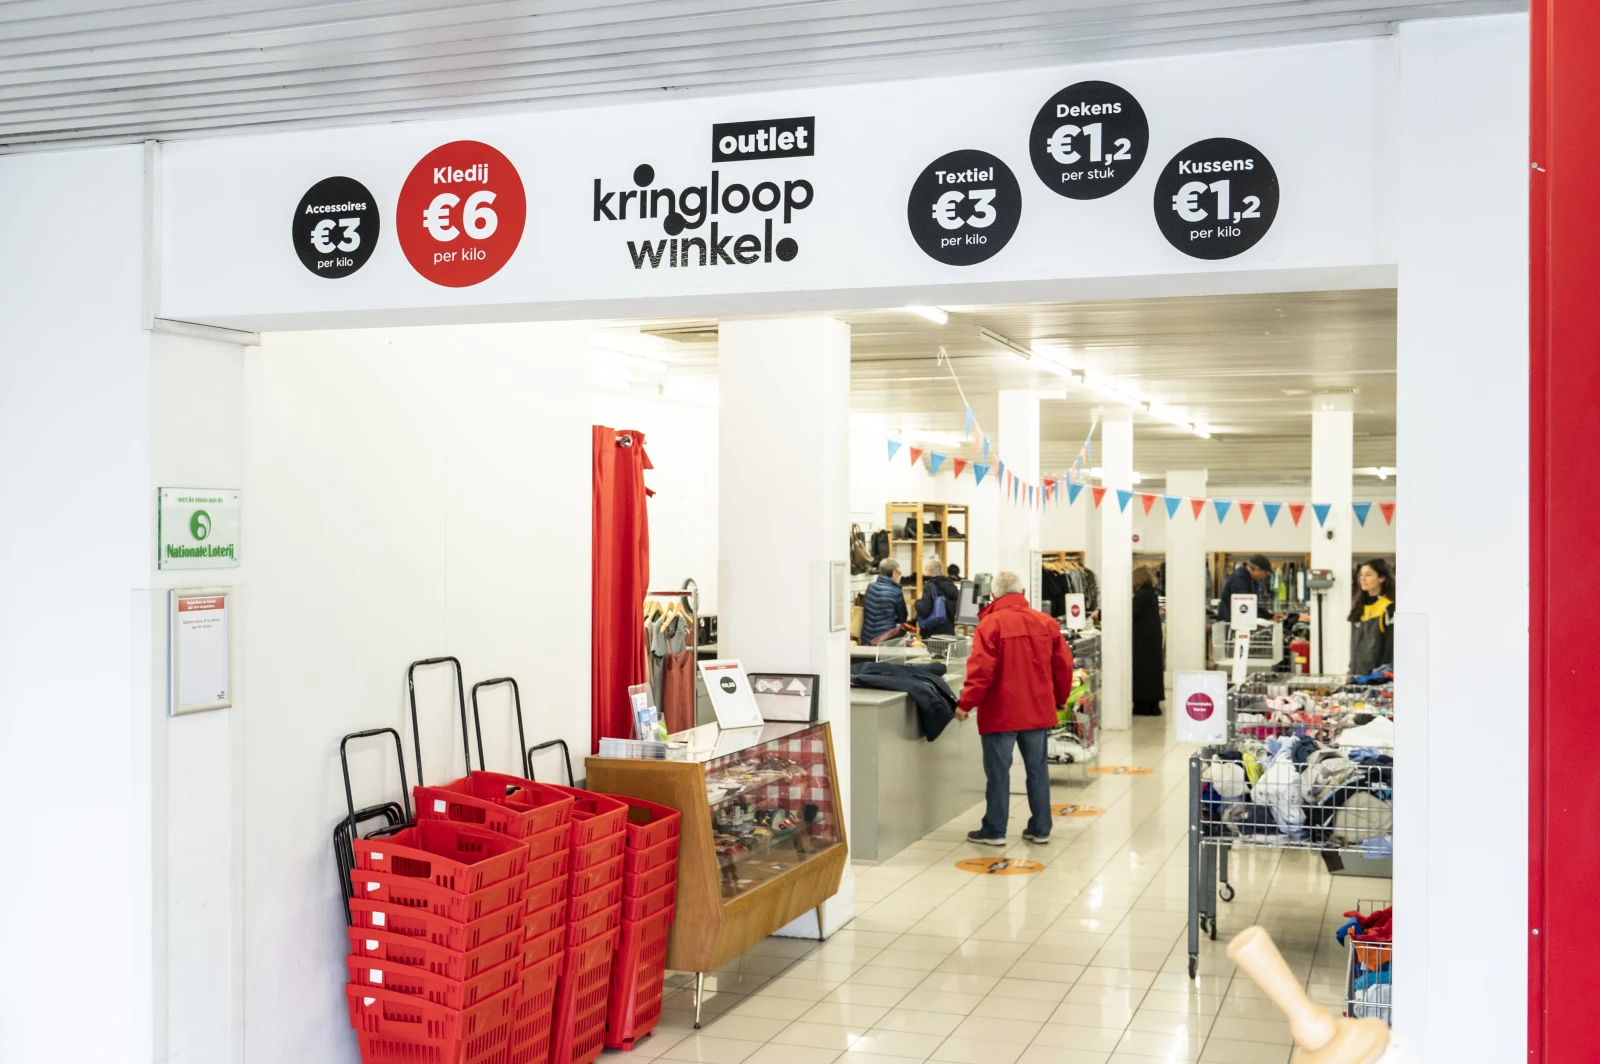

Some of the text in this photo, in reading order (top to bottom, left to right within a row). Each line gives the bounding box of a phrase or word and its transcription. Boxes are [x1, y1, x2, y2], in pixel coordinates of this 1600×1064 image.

[1056, 101, 1122, 118] Dekens
[718, 126, 808, 155] outlet
[1046, 122, 1132, 166] €1,2
[433, 163, 490, 186] Kledij
[935, 166, 994, 185] Textiel
[1061, 167, 1115, 183] per stuk
[1178, 157, 1254, 175] Kussens
[594, 163, 813, 227] kringloop
[1171, 179, 1261, 224] €1,2
[305, 201, 367, 216] Accessoires
[422, 190, 499, 242] €6
[931, 188, 997, 230] €3
[310, 217, 361, 254] €3
[941, 233, 987, 249] per kilo
[1190, 225, 1241, 241] per kilo
[317, 256, 354, 270] per kilo
[433, 246, 487, 265] per kilo
[167, 544, 234, 560] Nationale Loterij
